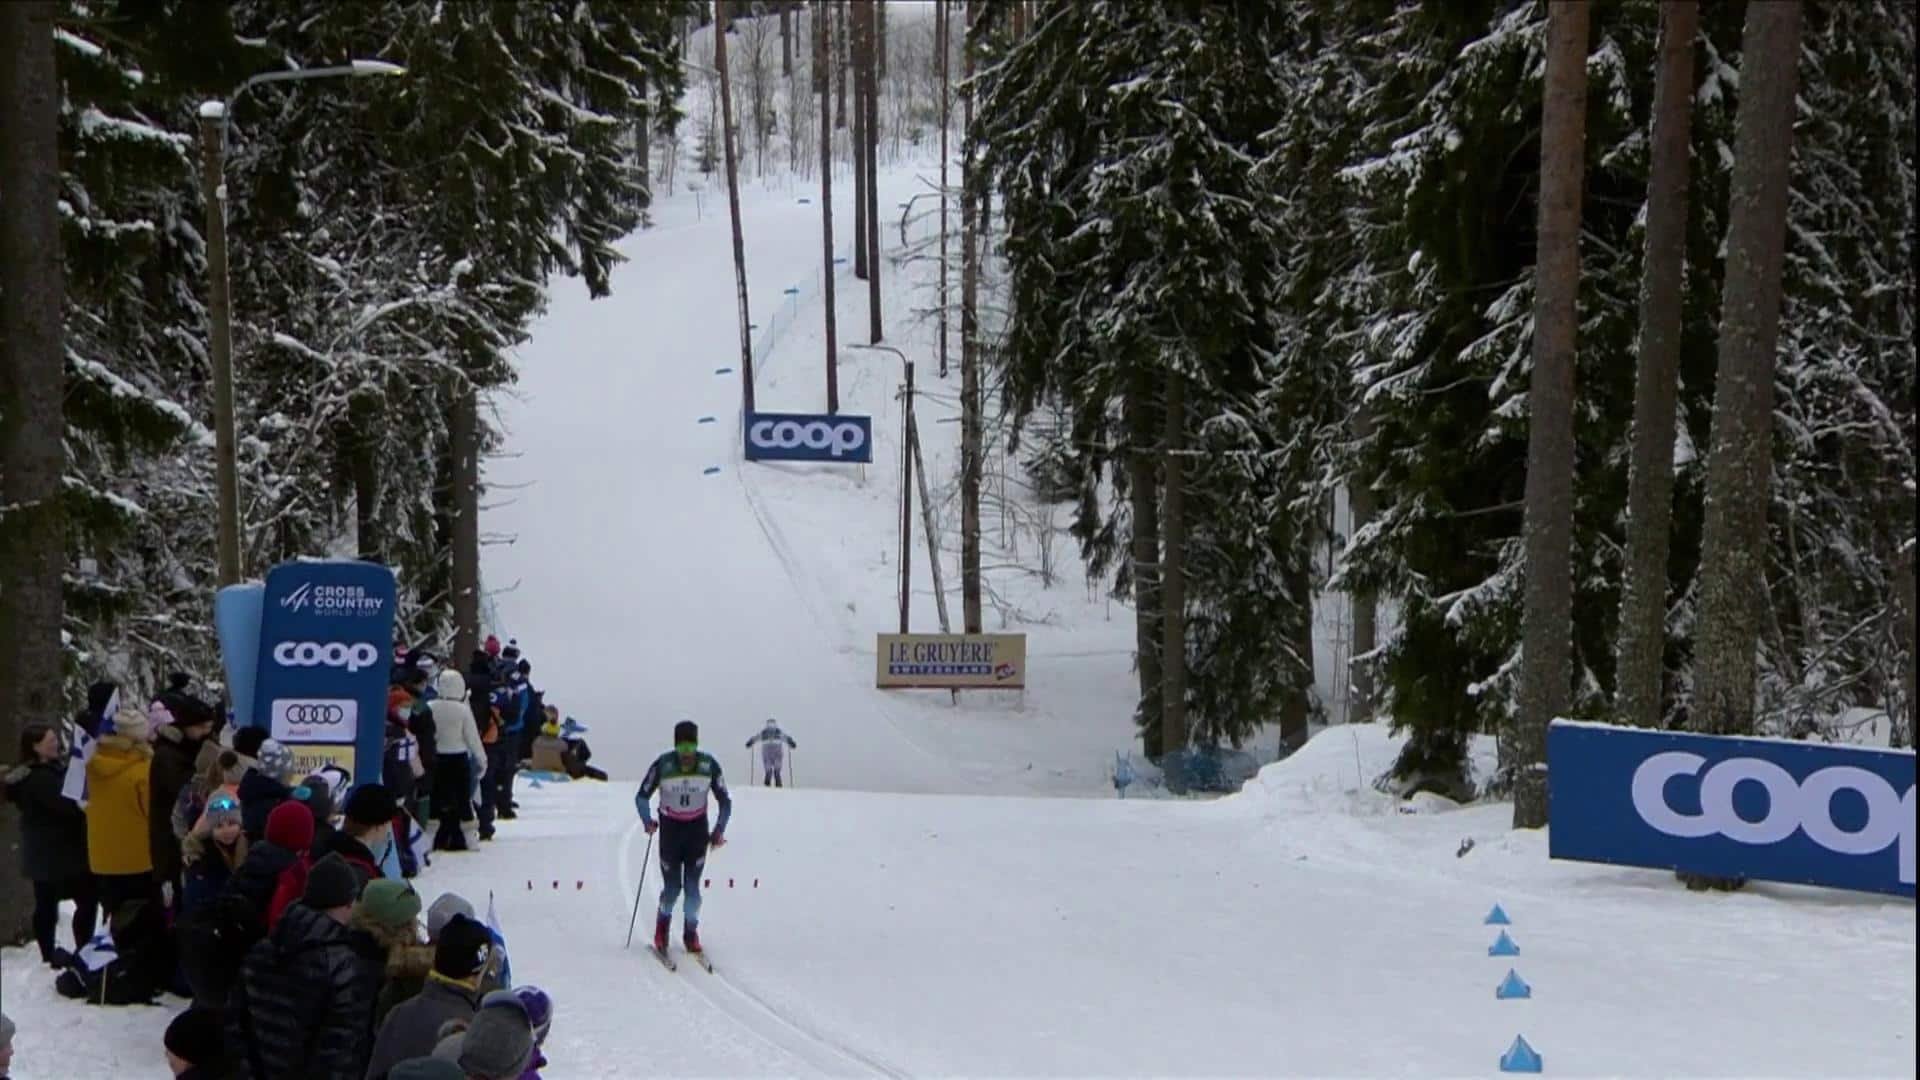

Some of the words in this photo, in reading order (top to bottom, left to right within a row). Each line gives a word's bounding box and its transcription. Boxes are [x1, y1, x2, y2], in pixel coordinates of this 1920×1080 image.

[750, 421, 864, 456] coop
[314, 586, 365, 597] CROSS
[314, 598, 384, 609] COUNTRY
[315, 608, 353, 617] WORLD
[273, 641, 378, 673] coop
[889, 642, 910, 663] LE
[913, 639, 993, 663] GRUYÈRE
[287, 728, 312, 736] Audi
[1632, 751, 1916, 884] coo
